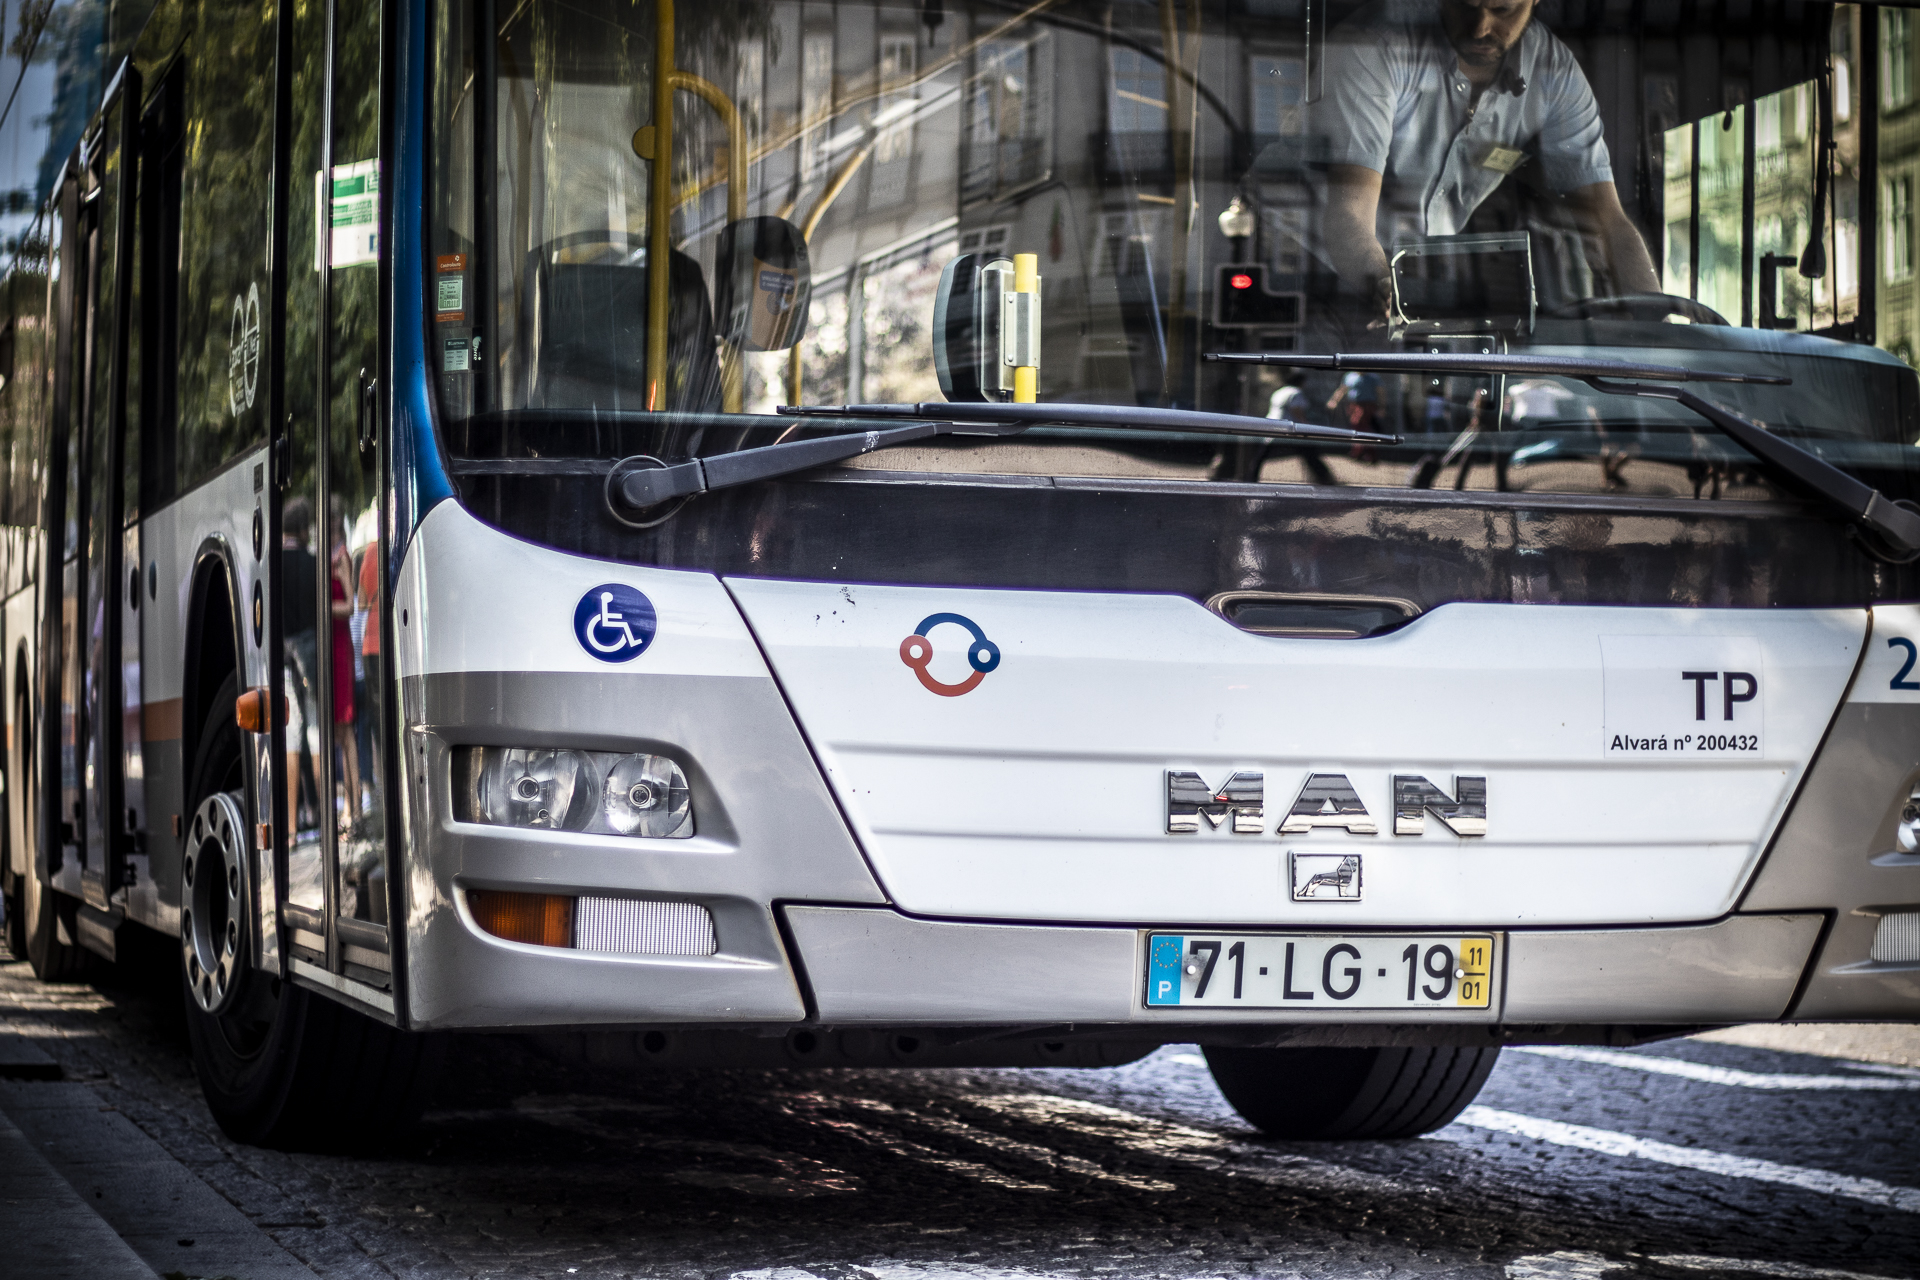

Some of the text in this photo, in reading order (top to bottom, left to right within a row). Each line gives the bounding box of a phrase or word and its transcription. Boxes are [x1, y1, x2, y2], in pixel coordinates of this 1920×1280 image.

[1887, 636, 1920, 690] 2
[1682, 671, 1758, 721] TP
[1611, 734, 1668, 751] Alvará
[1697, 735, 1758, 751] 200432
[1164, 768, 1488, 836] MAN
[1469, 947, 1483, 966] 11
[1158, 980, 1172, 999] P
[1462, 981, 1481, 1001] 01
